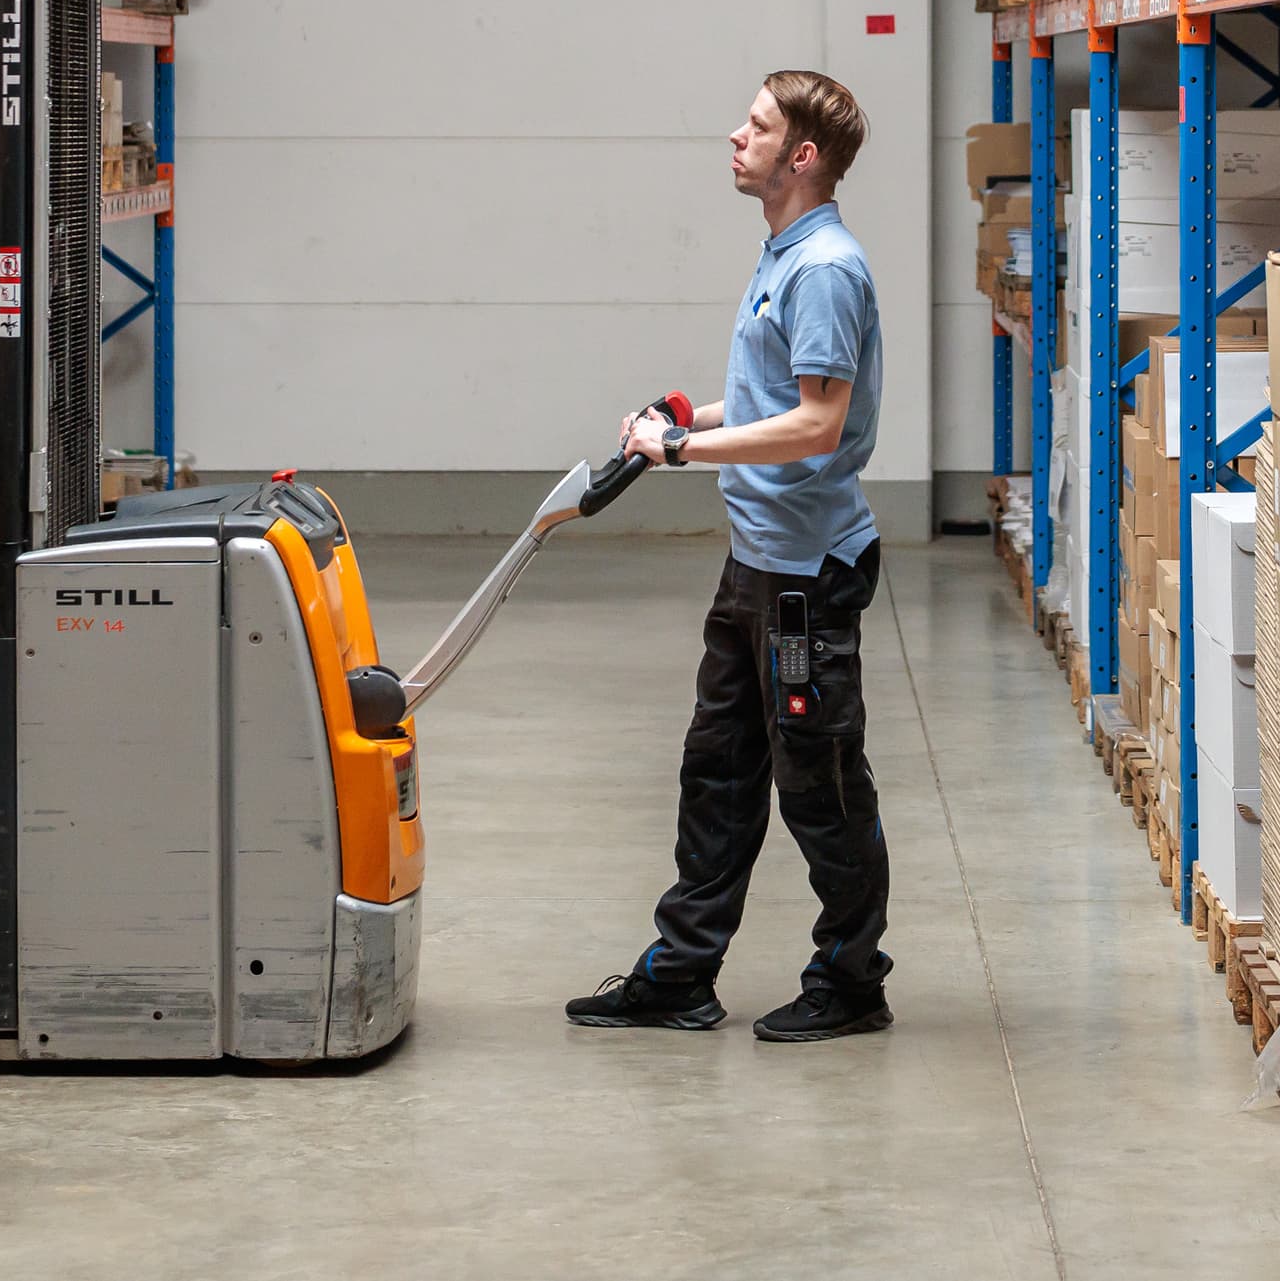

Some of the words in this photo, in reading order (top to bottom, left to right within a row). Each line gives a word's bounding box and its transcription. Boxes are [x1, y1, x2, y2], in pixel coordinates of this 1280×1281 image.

[2, 0, 21, 126] STILL
[56, 589, 174, 606] STILL
[56, 616, 95, 632] EXV
[103, 619, 126, 633] 14
